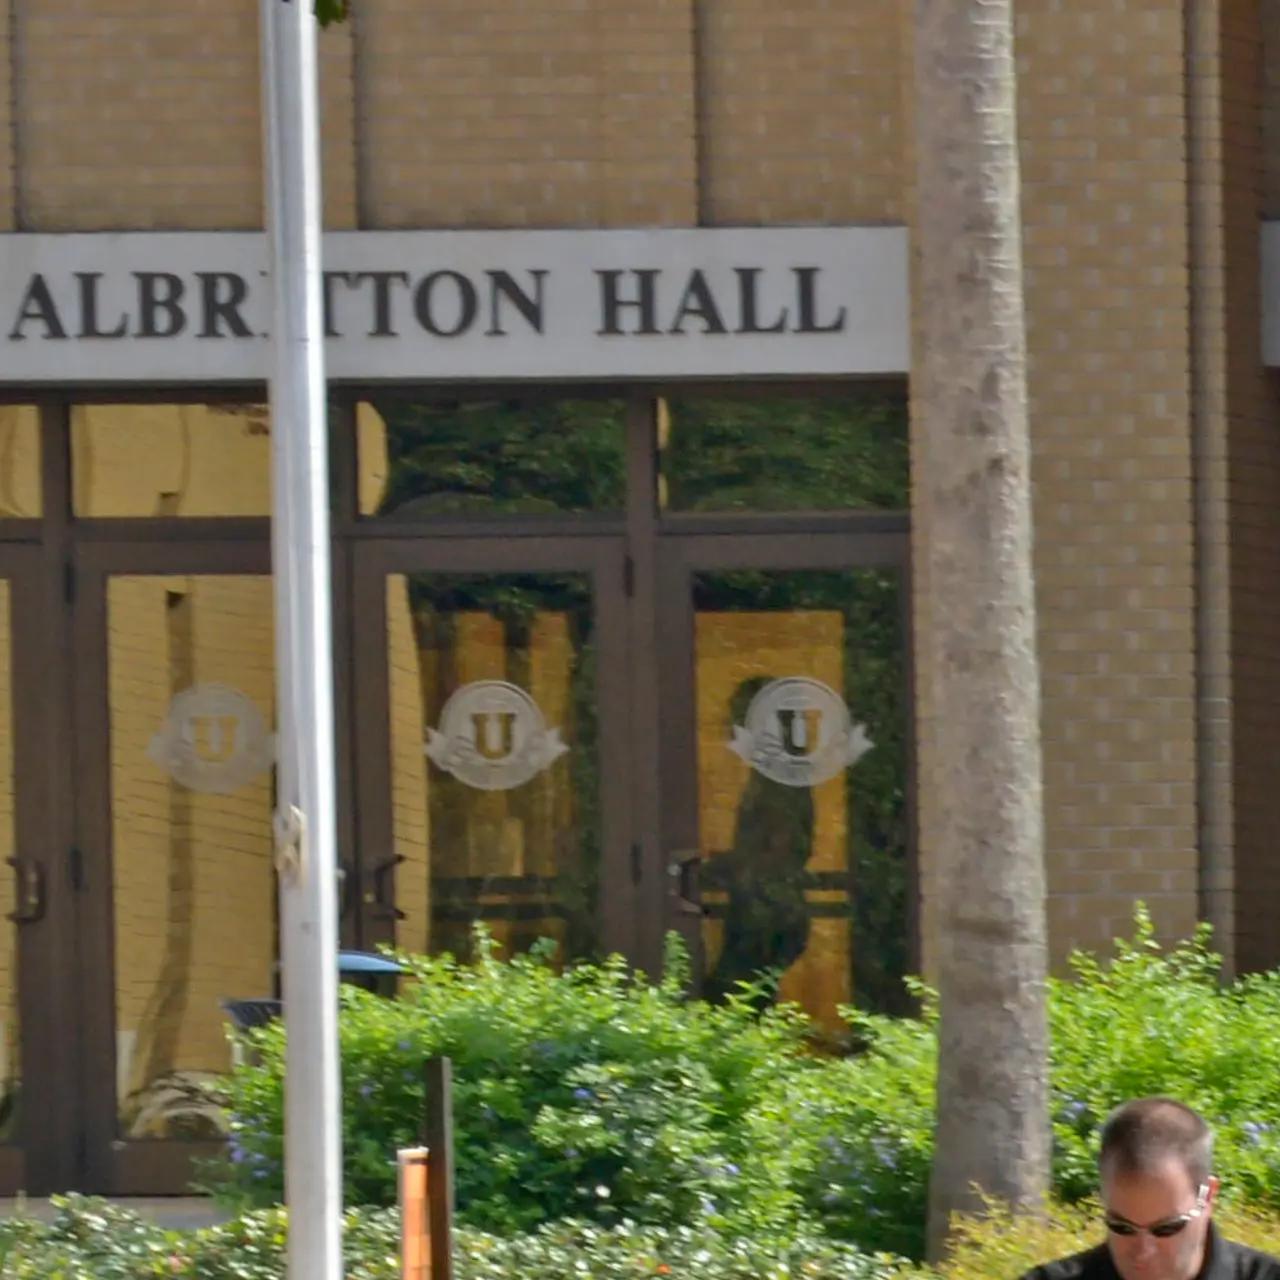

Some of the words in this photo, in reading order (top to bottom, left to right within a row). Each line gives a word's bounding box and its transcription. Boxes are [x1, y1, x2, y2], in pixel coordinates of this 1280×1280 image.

[8, 269, 546, 340] ALBRTTON
[595, 266, 847, 334] HALL
[471, 712, 517, 759] U
[777, 709, 822, 757] U
